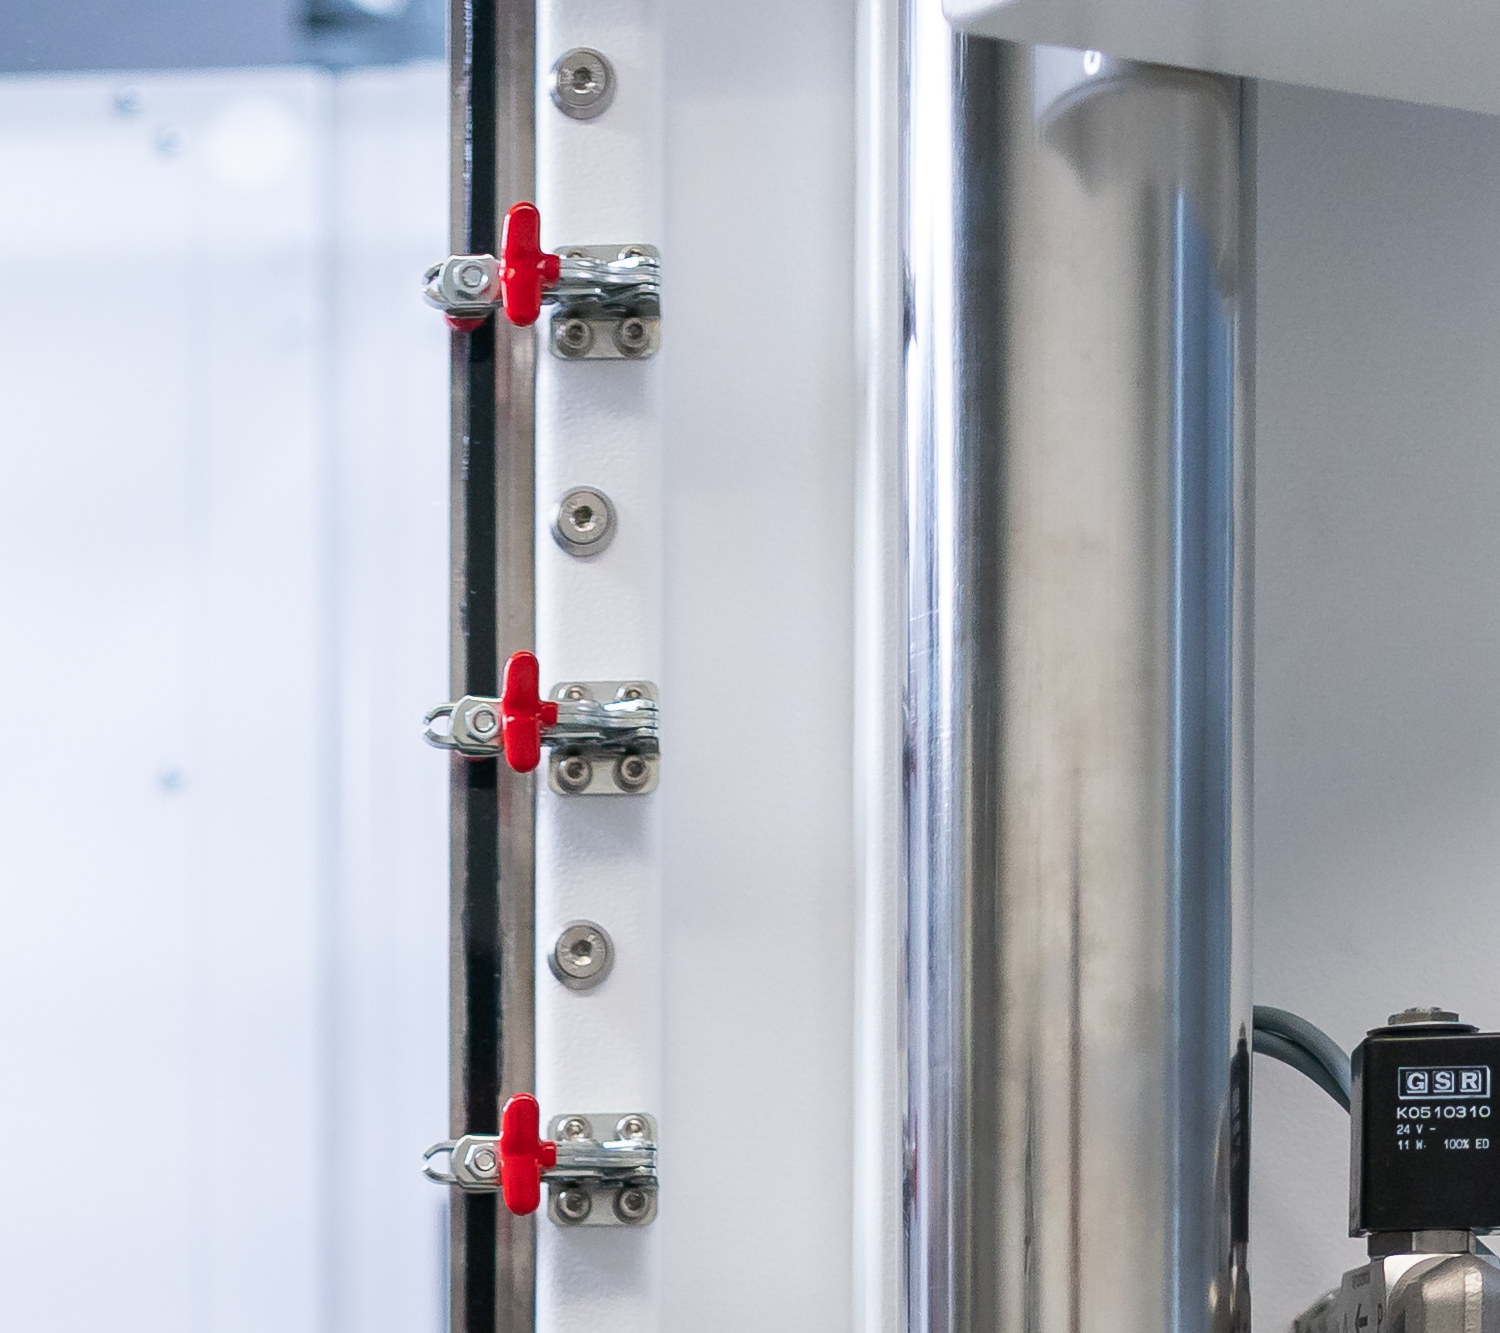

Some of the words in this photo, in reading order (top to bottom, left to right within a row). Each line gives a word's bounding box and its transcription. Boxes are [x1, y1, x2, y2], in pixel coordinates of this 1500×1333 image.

[1406, 1071, 1479, 1092] GSR
[1397, 1105, 1491, 1119] K0510310
[1396, 1124, 1410, 1135] 24
[1416, 1124, 1424, 1134] V
[1398, 1140, 1409, 1150] 11
[1444, 1139, 1470, 1149] 100%
[1475, 1138, 1490, 1149] ED
